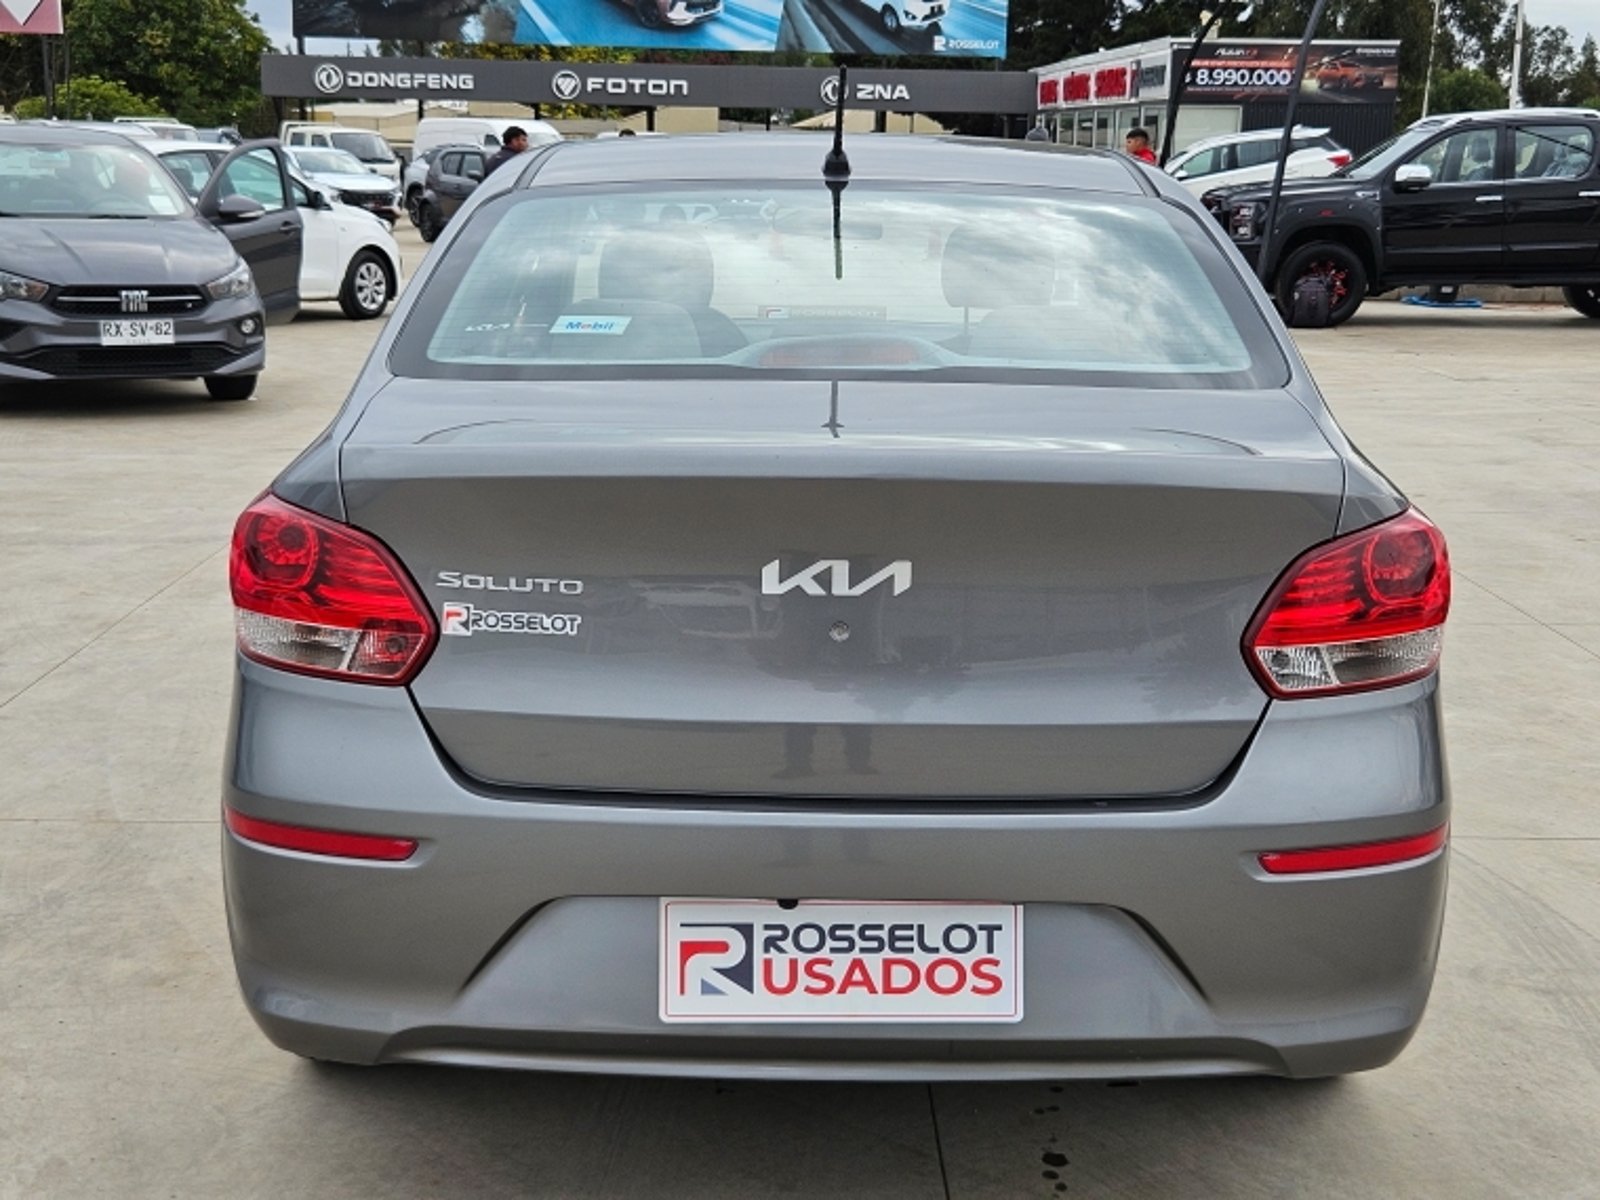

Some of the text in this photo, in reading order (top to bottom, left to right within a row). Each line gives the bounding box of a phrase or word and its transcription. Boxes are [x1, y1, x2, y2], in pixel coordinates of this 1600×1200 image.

[948, 39, 999, 49] ROSSELOT
[346, 70, 475, 90] DONGFENG
[586, 77, 689, 96] FOTON
[855, 82, 911, 101] ZNA
[565, 321, 616, 331] Mobil
[435, 570, 584, 595] SOLUTO
[761, 558, 913, 597] KIA
[471, 610, 581, 633] ROSSELOT
[762, 923, 1004, 955] ROSSELOT
[762, 957, 1004, 997] USADOS
